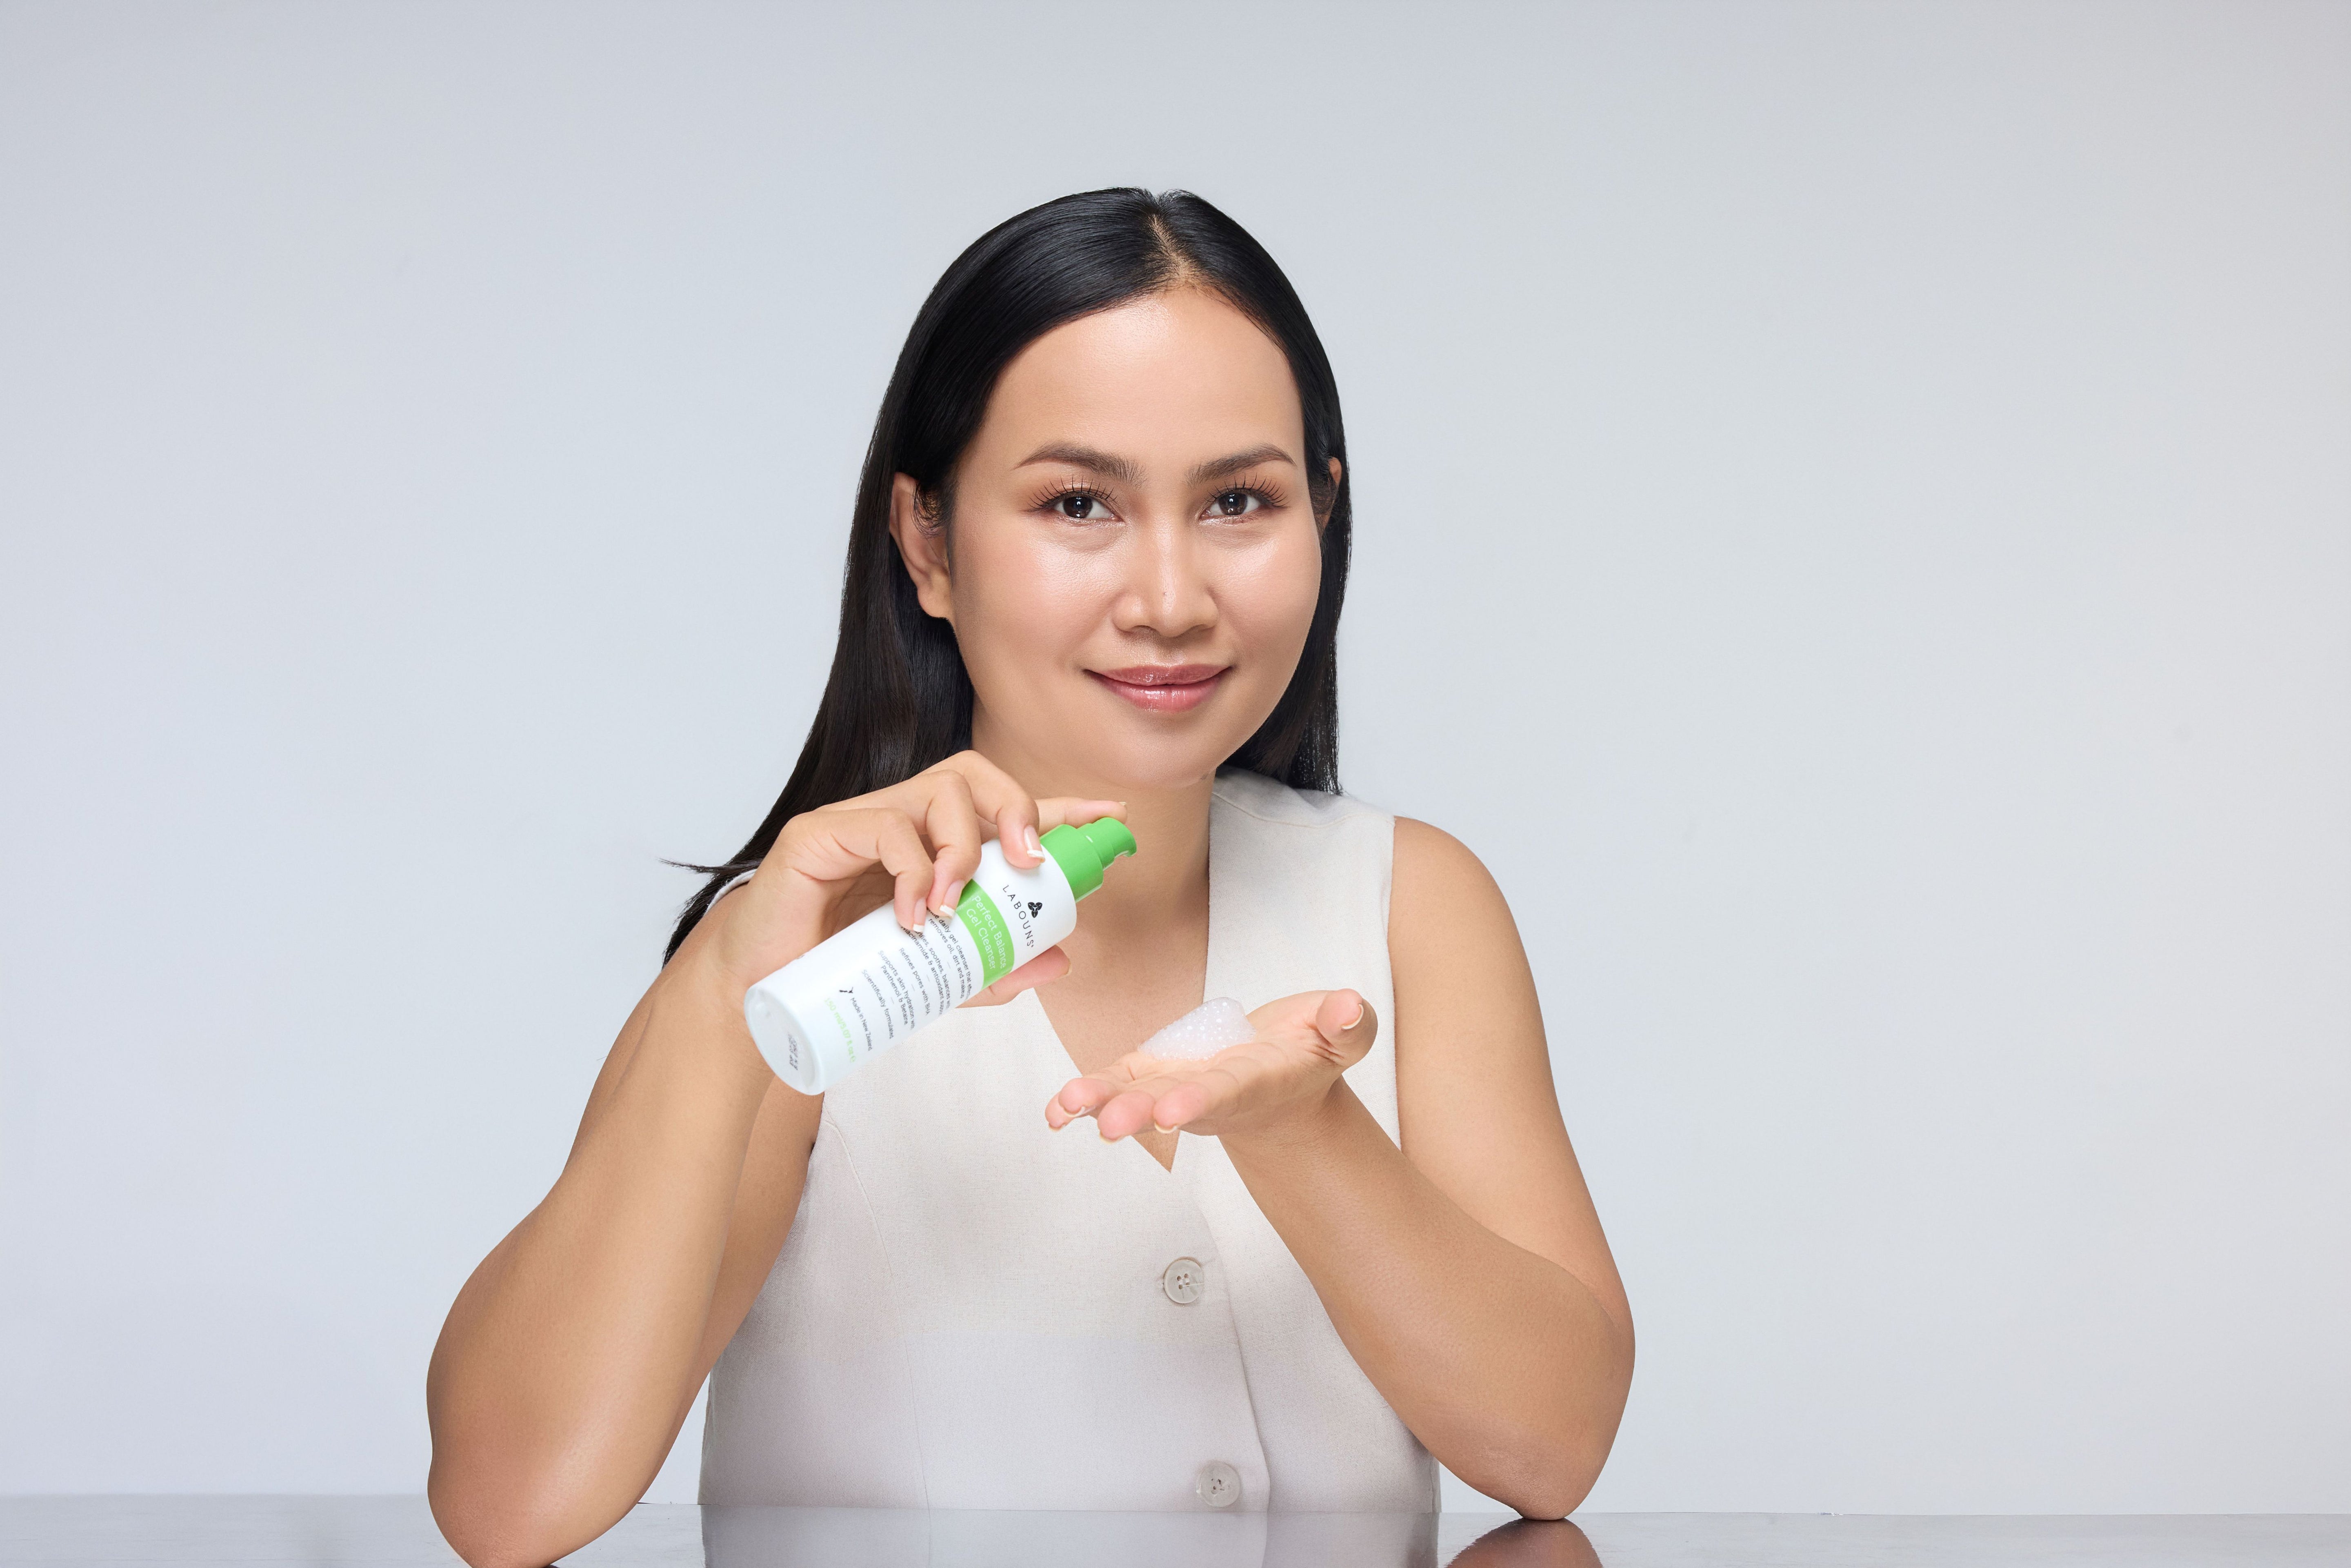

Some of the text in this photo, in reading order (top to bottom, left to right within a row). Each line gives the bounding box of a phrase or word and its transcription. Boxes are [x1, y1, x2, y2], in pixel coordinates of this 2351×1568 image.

[928, 919, 948, 943] removes
[967, 909, 996, 969] Gel Cleanser
[972, 895, 1006, 969] Perfect Balance
[1002, 885, 1033, 947] LABOUNS
[899, 948, 915, 970] Refines
[913, 971, 924, 988] pores
[939, 919, 951, 933] daily
[949, 934, 958, 944] gel
[956, 945, 969, 970] cleanser
[878, 950, 898, 976] Supports
[898, 977, 906, 990] skin
[904, 990, 915, 1019] hydration
[881, 965, 902, 997] Panthenol
[929, 948, 944, 974] soothes,
[942, 974, 950, 999] balances
[931, 967, 944, 1000] antioxidant
[824, 997, 836, 1011] 150
[850, 997, 861, 1013] Made
[862, 969, 894, 1039] Scientifically formulated
